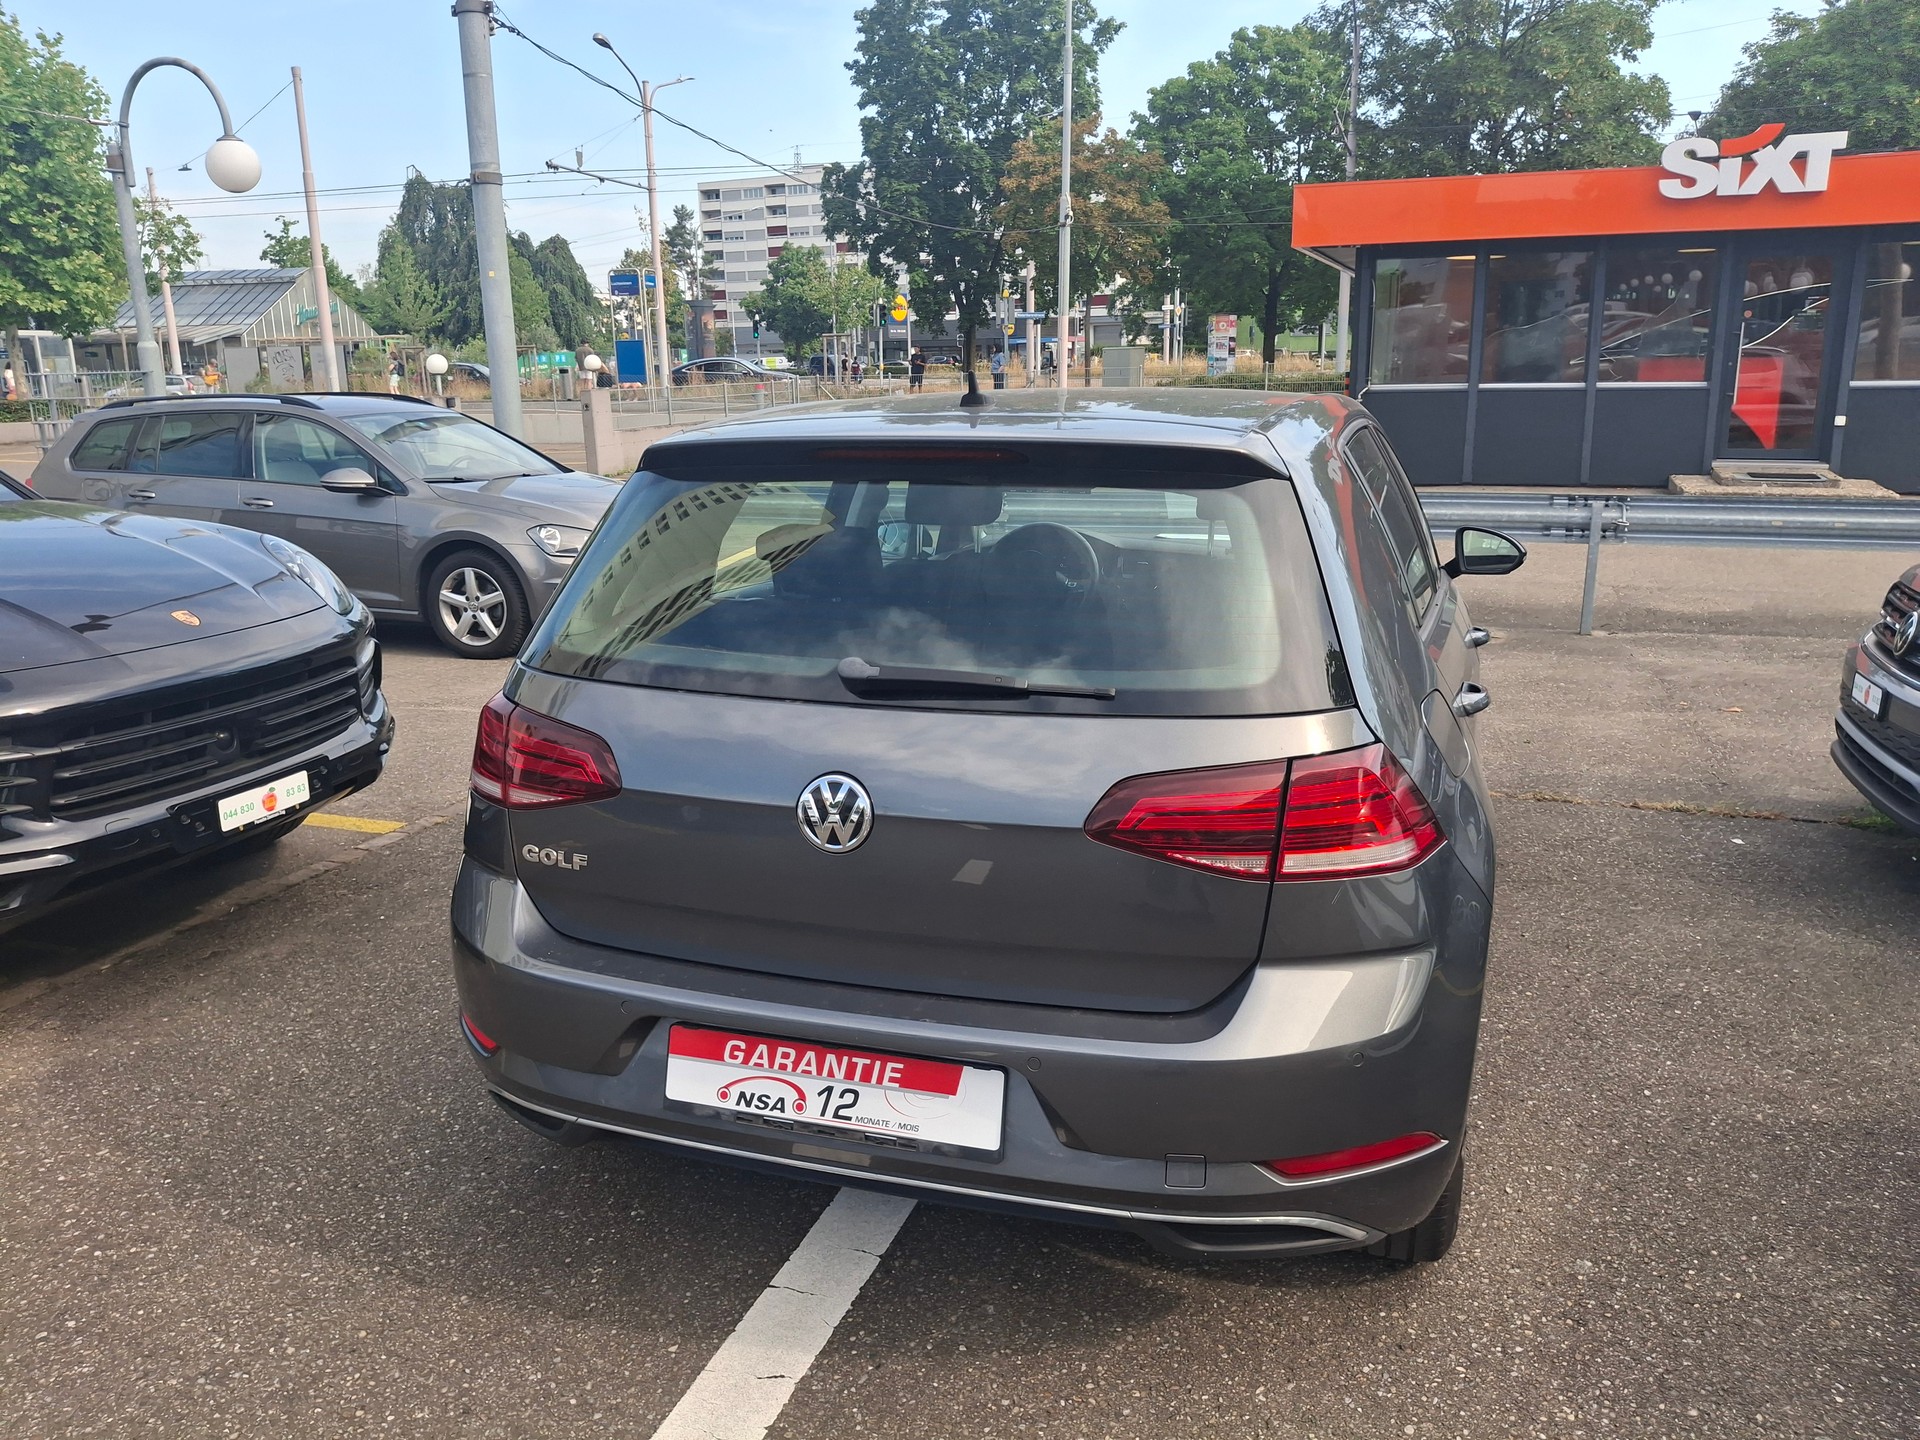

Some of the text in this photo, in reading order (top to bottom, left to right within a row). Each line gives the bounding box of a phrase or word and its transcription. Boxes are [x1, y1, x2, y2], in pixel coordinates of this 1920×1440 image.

[223, 809, 238, 820] 044
[240, 802, 254, 814] 830
[286, 788, 296, 797] 83
[296, 783, 306, 792] 83
[521, 843, 589, 871] GOLF
[724, 1040, 904, 1088] GARANTIE
[735, 1091, 786, 1114] NSA
[817, 1086, 860, 1121] 12
[854, 1115, 891, 1128] MONATE
[897, 1122, 920, 1133] MOIS
